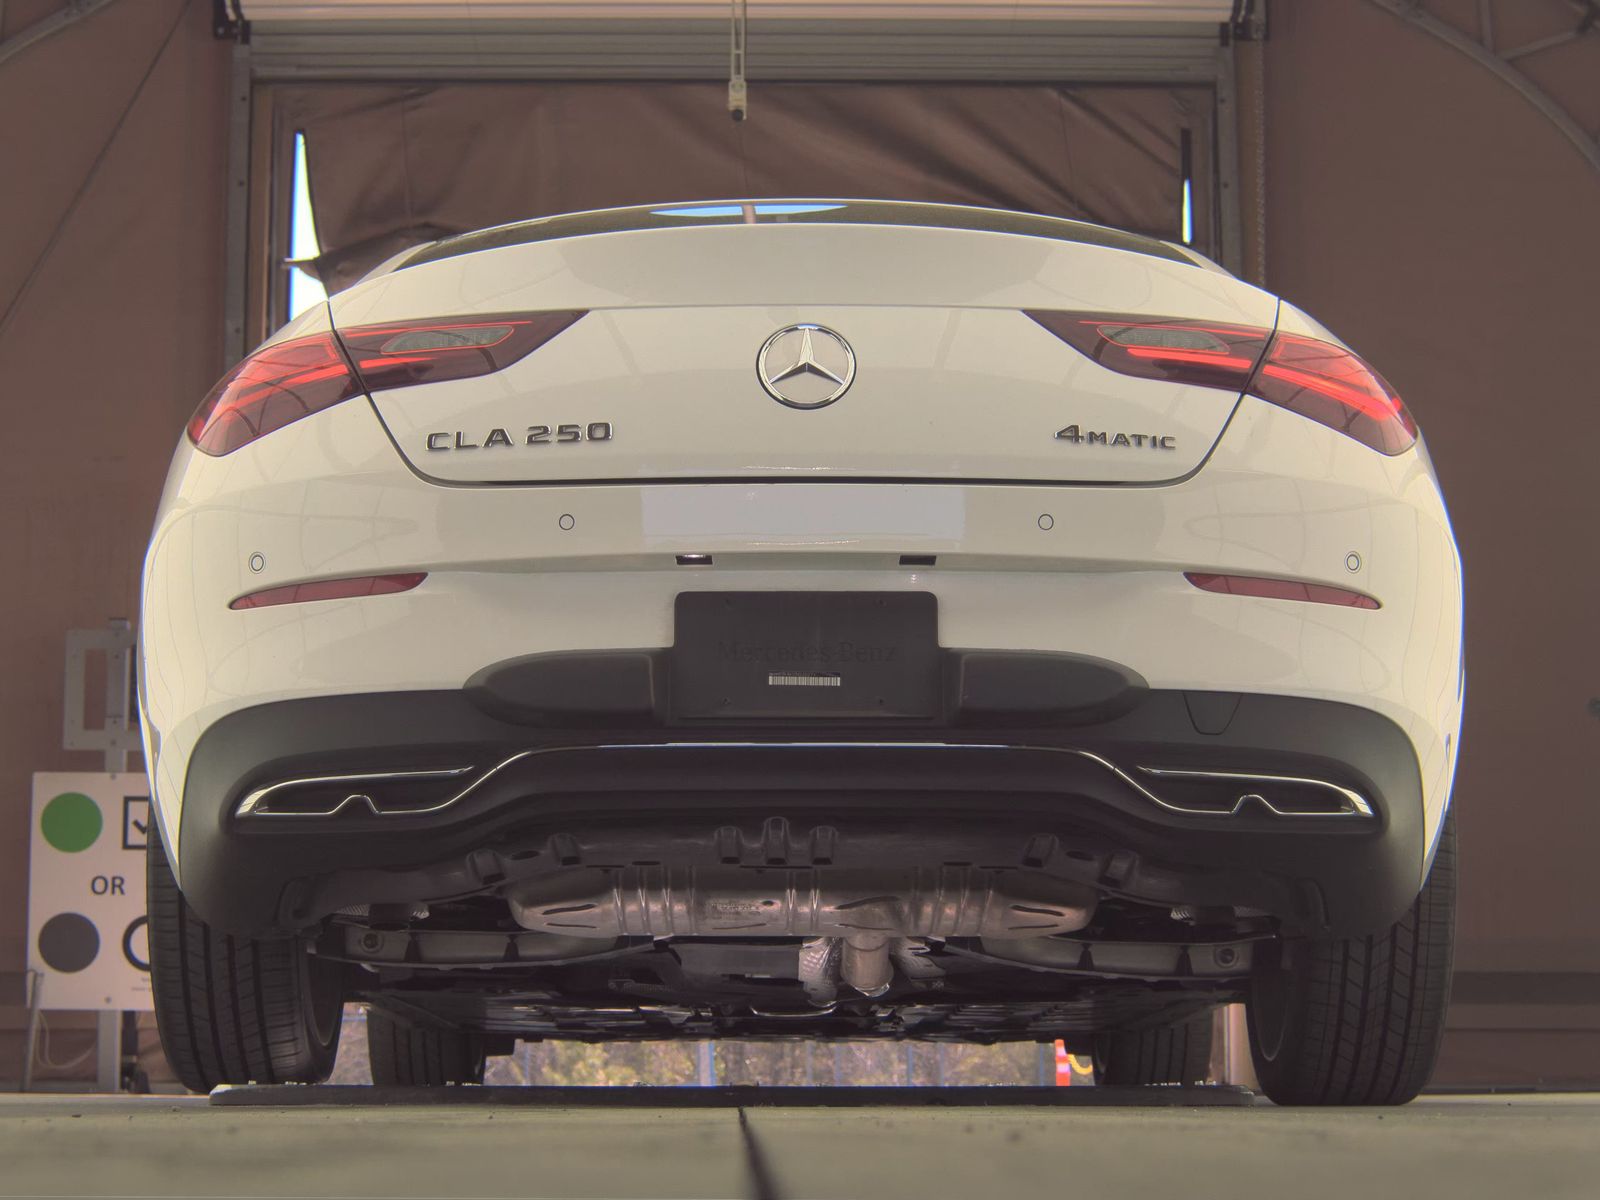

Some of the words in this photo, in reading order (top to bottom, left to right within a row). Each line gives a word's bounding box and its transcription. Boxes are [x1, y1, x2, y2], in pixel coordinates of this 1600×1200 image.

[426, 428, 513, 450] CLA
[524, 422, 613, 444] 250
[1054, 424, 1176, 450] 4MATIC
[91, 876, 125, 895] OR
